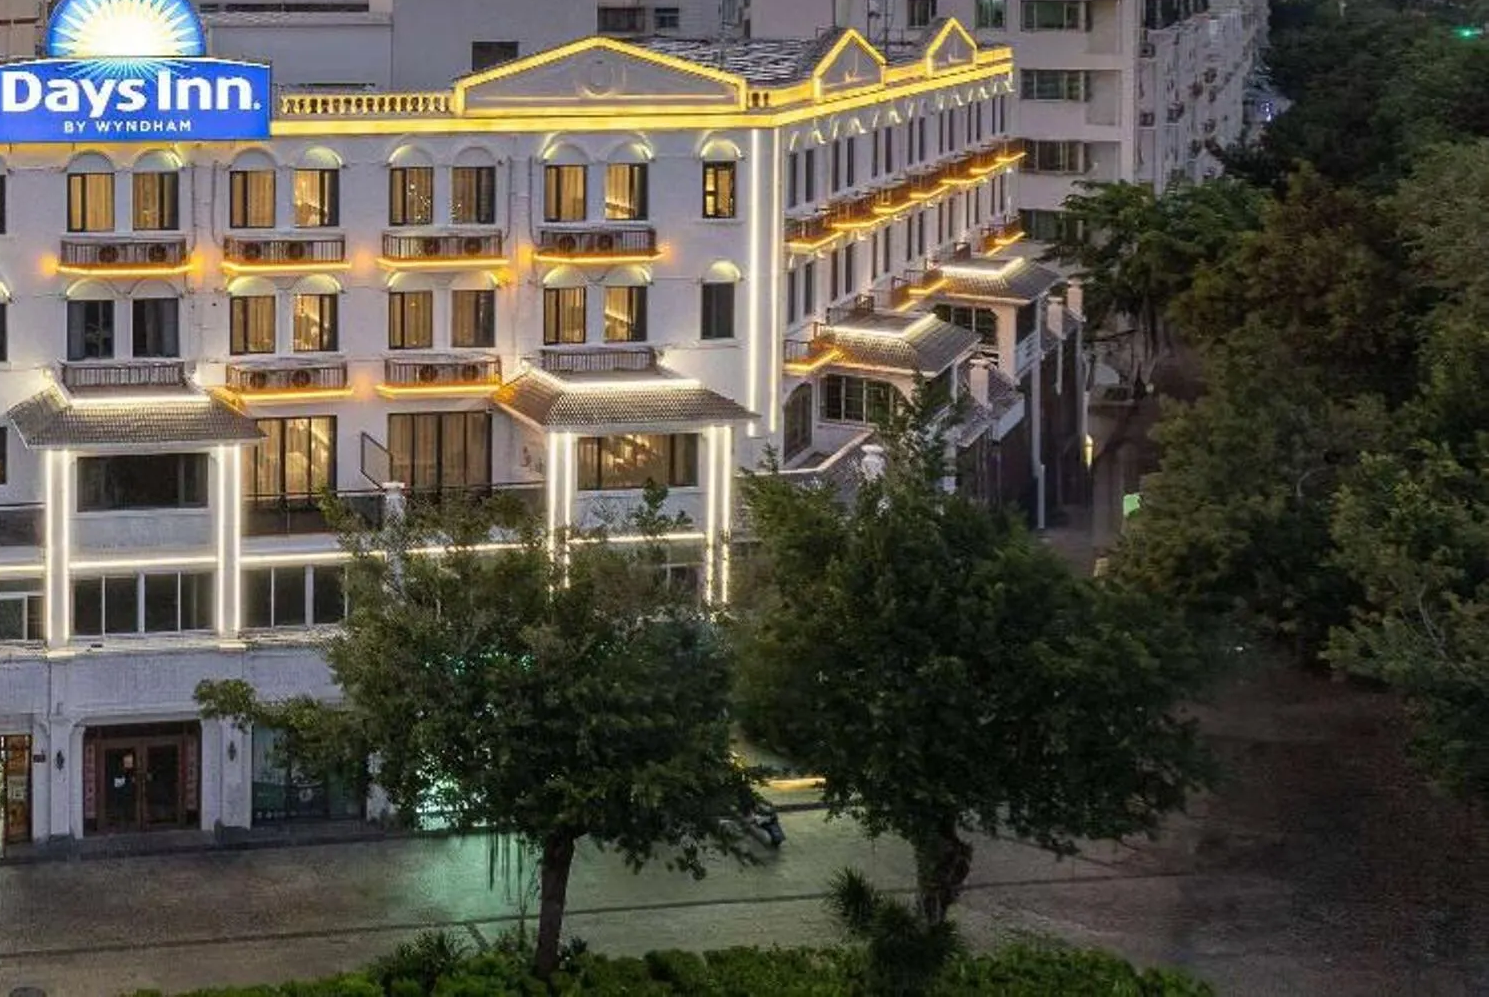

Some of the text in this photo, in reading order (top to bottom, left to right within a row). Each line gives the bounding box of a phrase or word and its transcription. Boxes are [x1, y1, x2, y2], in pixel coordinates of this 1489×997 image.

[1, 70, 146, 118] Days
[64, 120, 192, 133] BY WYNDHAM
